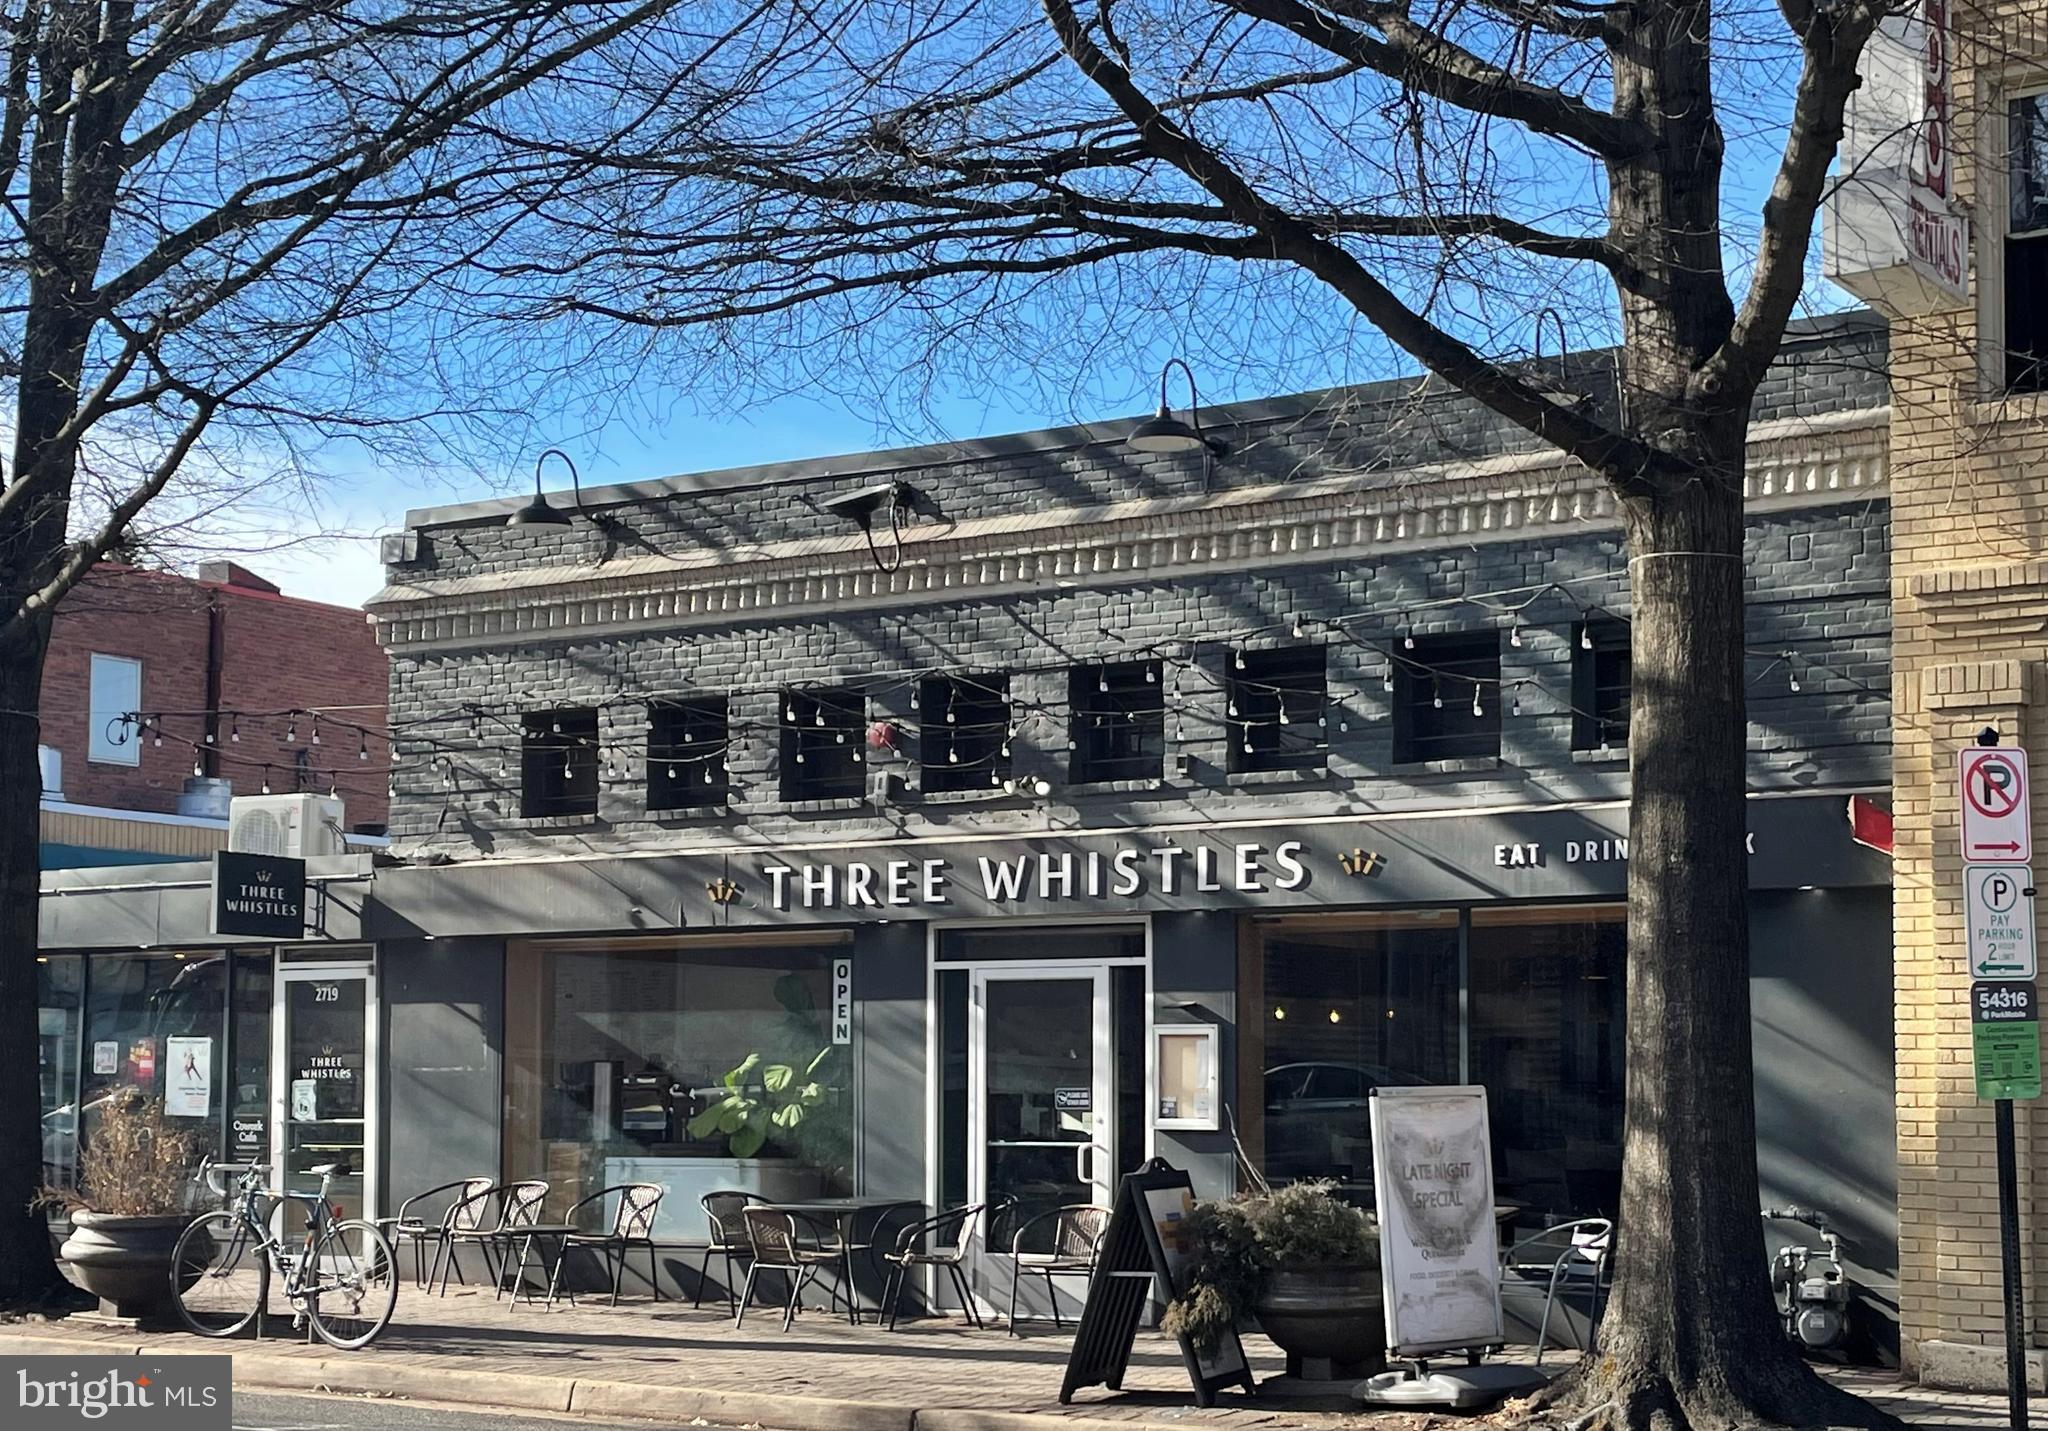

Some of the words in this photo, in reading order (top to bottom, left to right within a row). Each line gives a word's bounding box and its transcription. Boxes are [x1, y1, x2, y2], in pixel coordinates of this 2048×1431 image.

[1494, 843, 1539, 866] EAT
[1566, 838, 1629, 863] DRIN
[764, 859, 946, 909] THREE
[977, 841, 1304, 899] WHISTLES
[239, 884, 286, 901] THREE
[1994, 879, 2007, 906] P
[225, 899, 298, 917] WHISTLES
[1990, 914, 2010, 927] PAY
[1978, 928, 2024, 941] PARKING
[1987, 942, 1997, 961] 2
[315, 987, 339, 1002] 2719
[836, 963, 848, 1039] OPEN
[1979, 991, 2028, 1008] 54316
[310, 1057, 342, 1067] THREE
[301, 1068, 352, 1079] WHISTLES
[1402, 1163, 1432, 1181] LATE
[1434, 1162, 1471, 1180] NIGHT
[1415, 1190, 1463, 1209] SPECIAL
